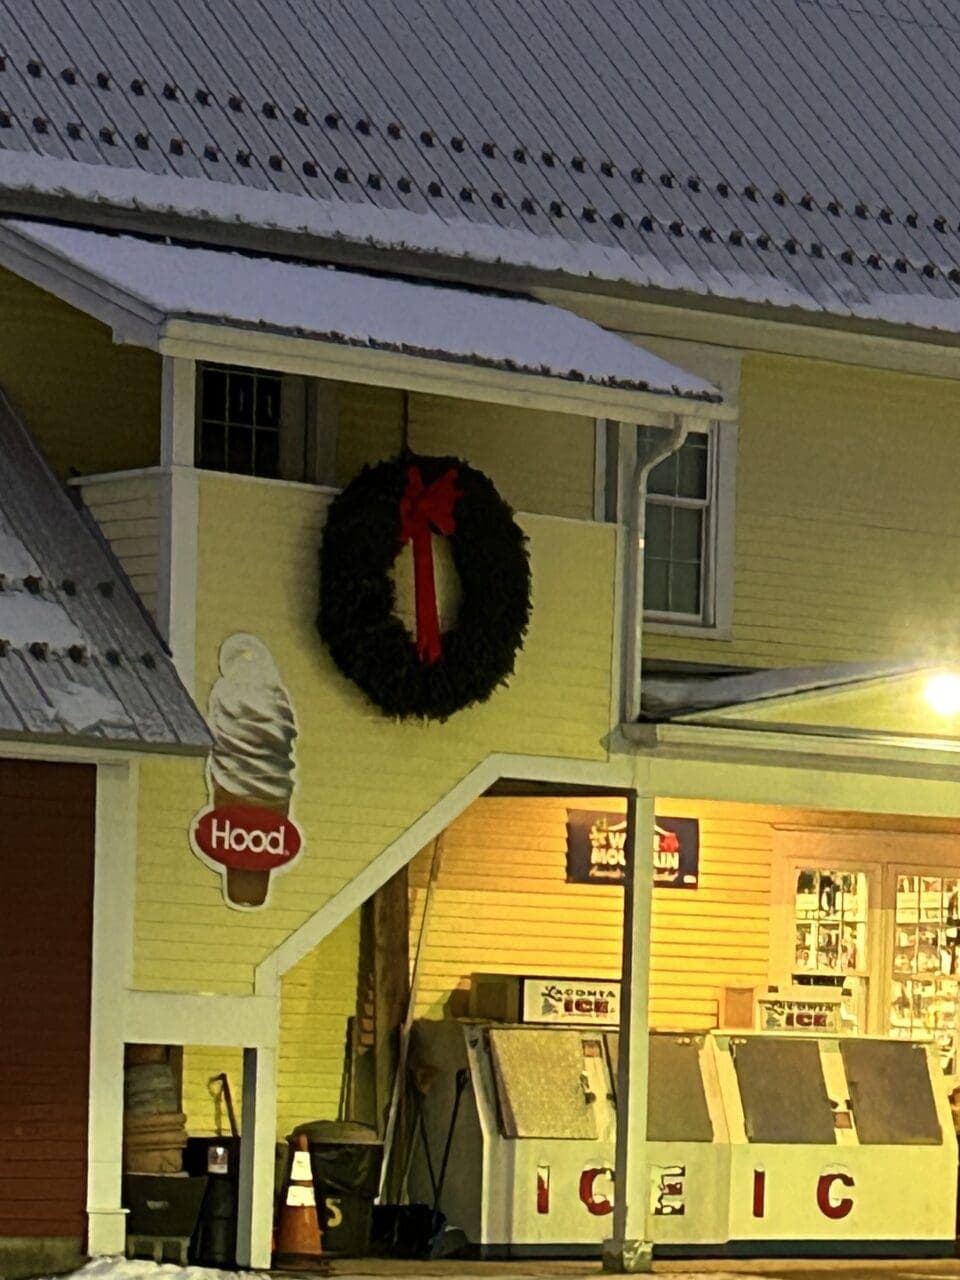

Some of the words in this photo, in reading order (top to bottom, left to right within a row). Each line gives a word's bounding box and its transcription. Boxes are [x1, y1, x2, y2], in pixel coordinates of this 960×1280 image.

[211, 818, 285, 855] Hood
[564, 999, 609, 1013] ICE
[785, 1012, 827, 1027] ICE
